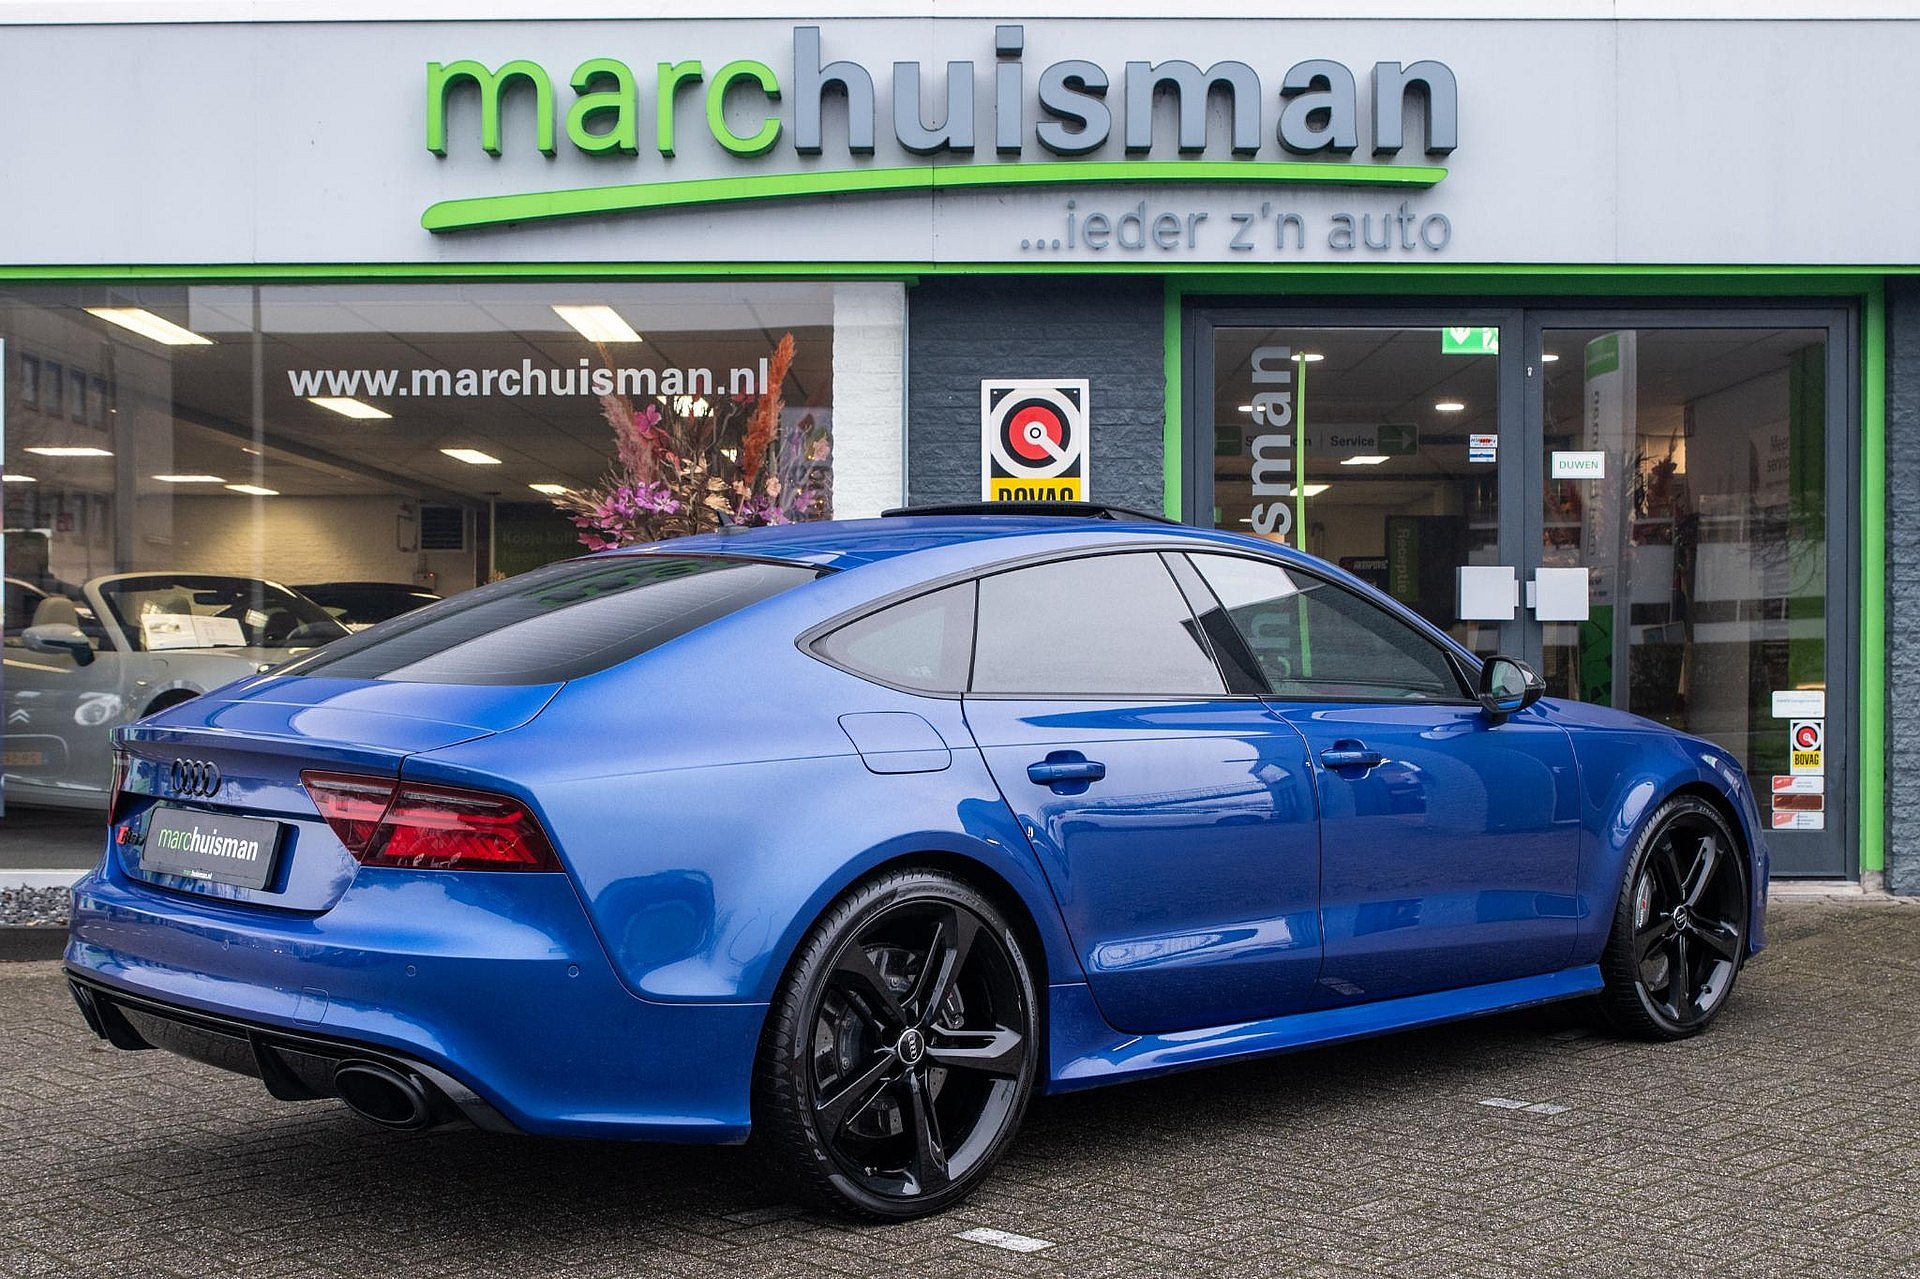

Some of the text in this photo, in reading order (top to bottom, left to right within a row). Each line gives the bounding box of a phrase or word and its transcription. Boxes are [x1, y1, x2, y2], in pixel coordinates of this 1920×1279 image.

[426, 25, 1459, 157] marchuisman
[1229, 202, 1304, 251] z'n
[1328, 201, 1454, 251] auto
[287, 357, 769, 397] www.marchuisman.nl
[1251, 346, 1292, 546] sman
[1331, 435, 1375, 447] Service
[1559, 460, 1599, 470] DUWEN
[1794, 753, 1819, 766] BOVAG
[157, 826, 259, 861] marchuisman
